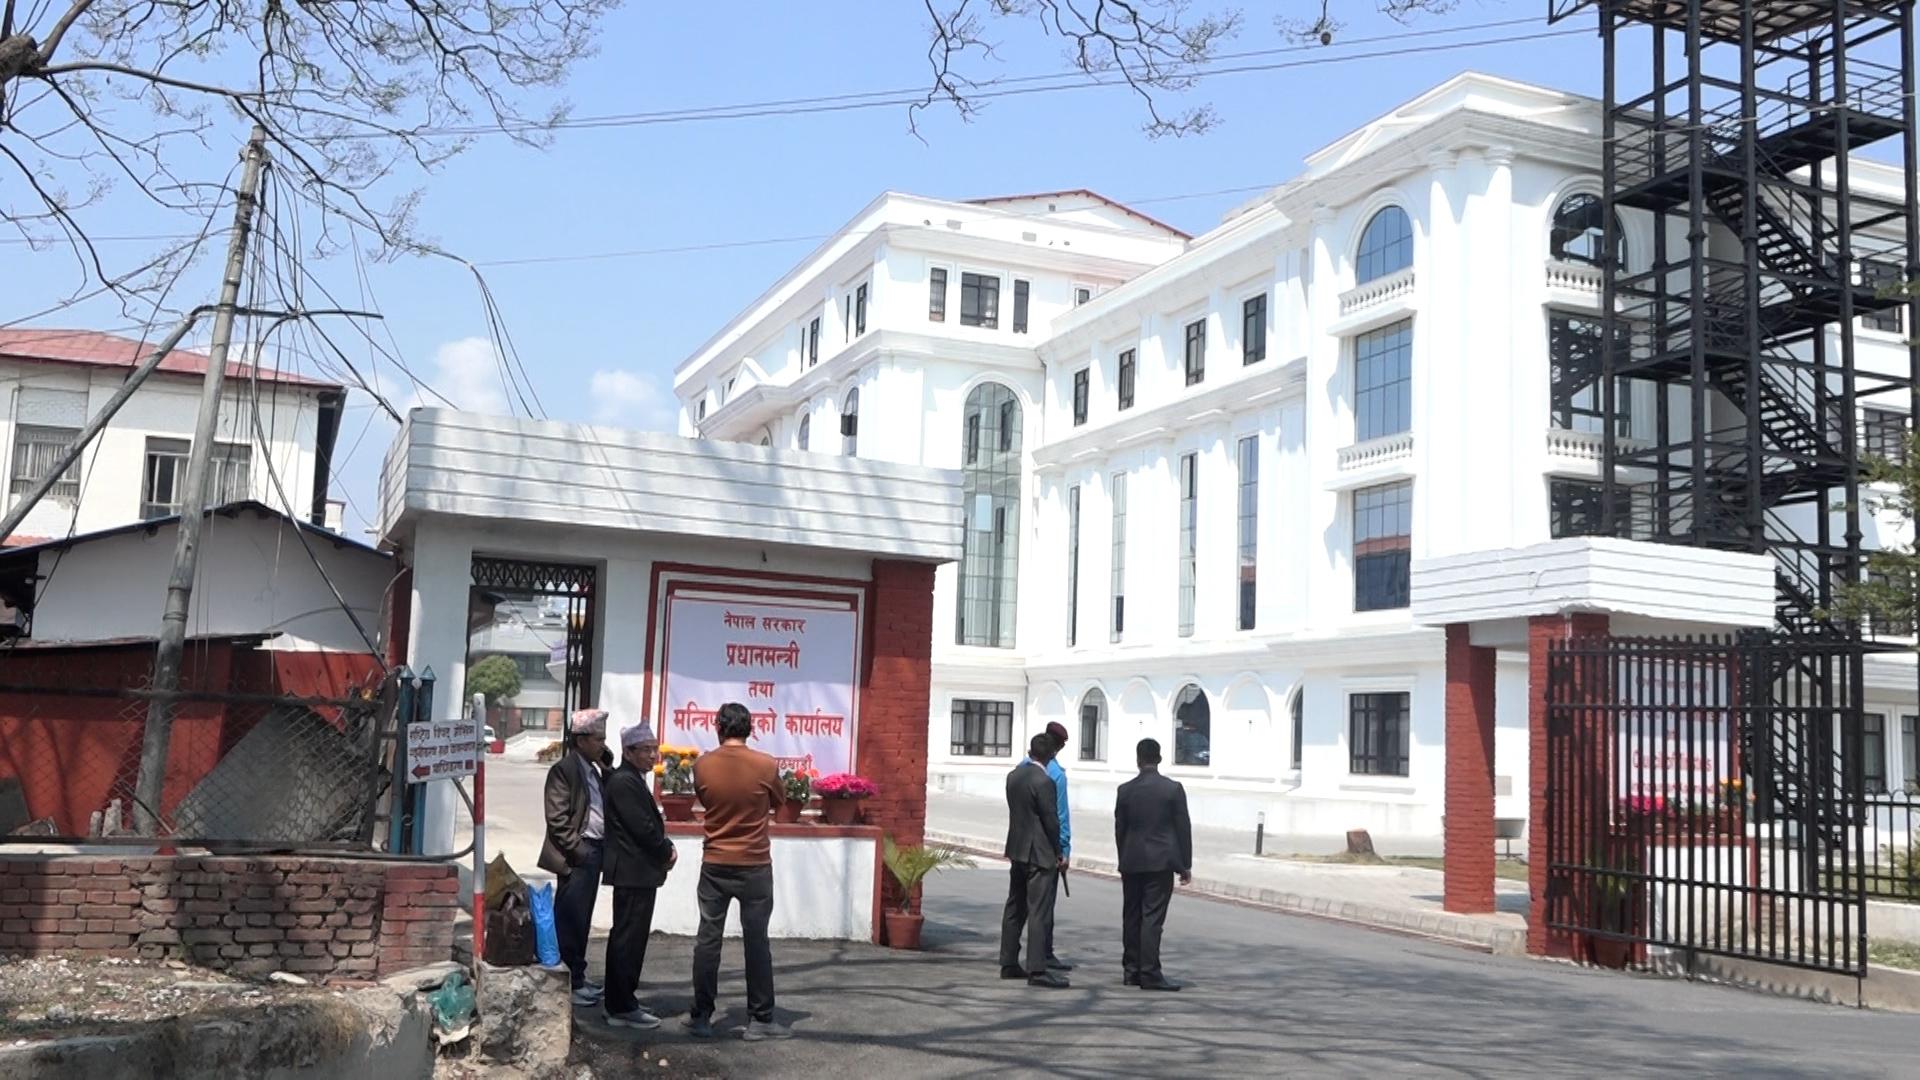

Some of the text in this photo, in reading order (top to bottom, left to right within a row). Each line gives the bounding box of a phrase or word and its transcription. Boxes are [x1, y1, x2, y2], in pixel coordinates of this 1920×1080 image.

[724, 611, 806, 633] नेपाल सरकार
[726, 640, 800, 669] प्रधानमन्त्री
[748, 681, 775, 699] तथा
[785, 708, 844, 738] कार्यालय
